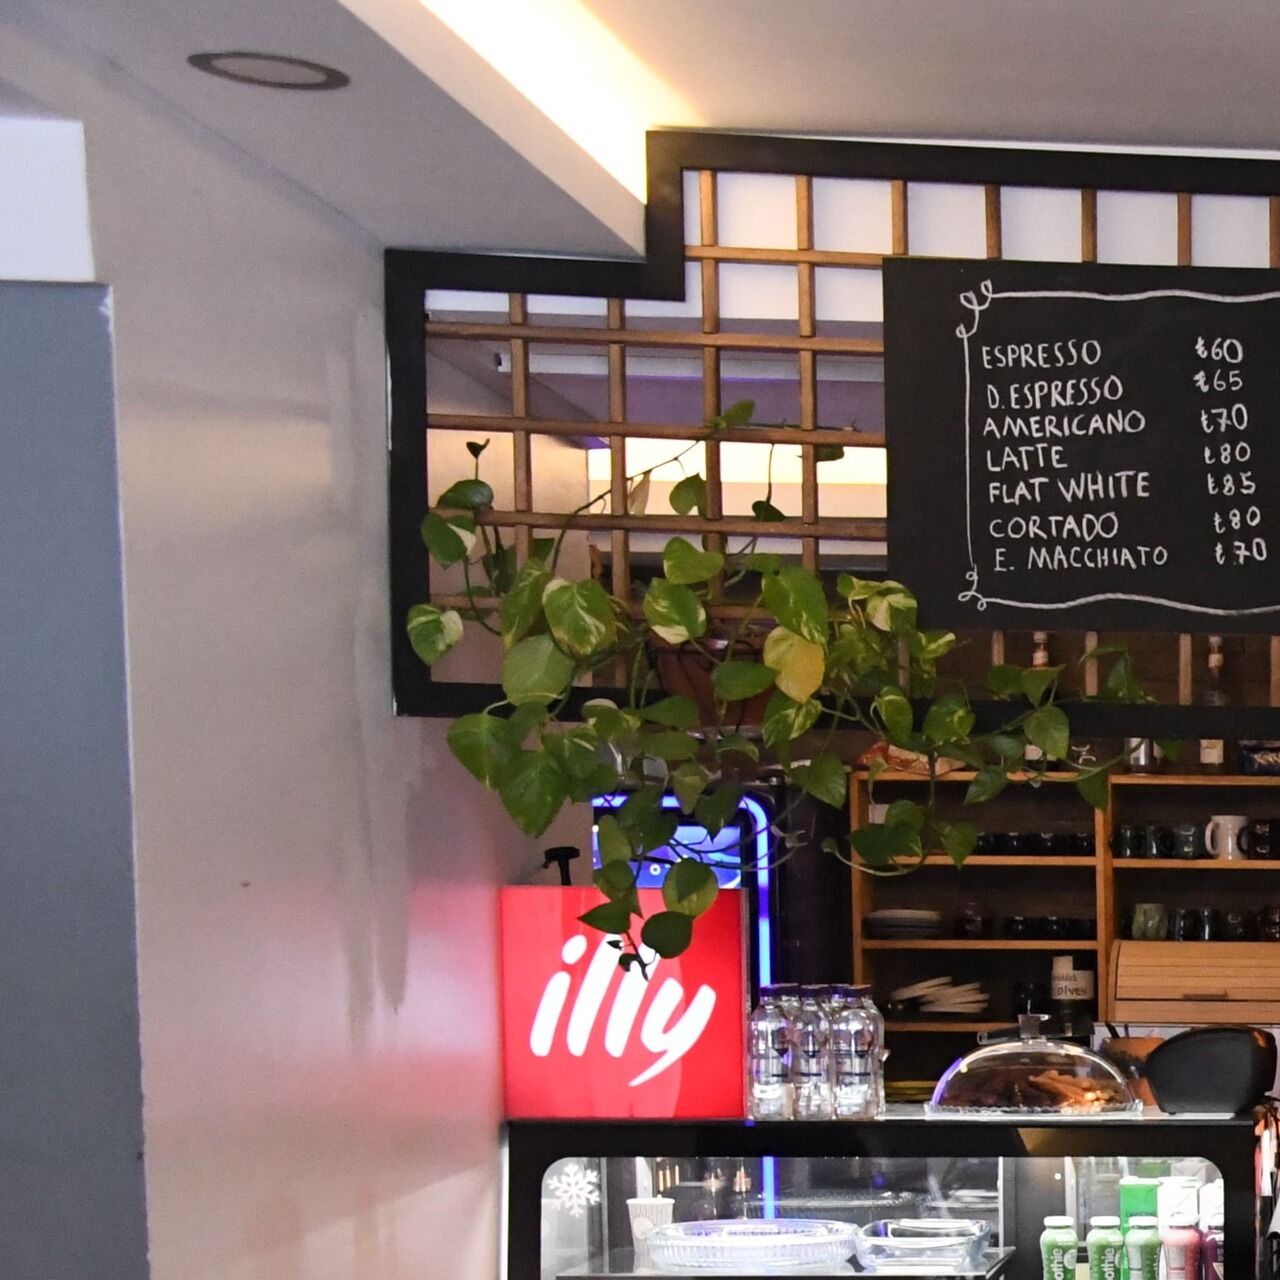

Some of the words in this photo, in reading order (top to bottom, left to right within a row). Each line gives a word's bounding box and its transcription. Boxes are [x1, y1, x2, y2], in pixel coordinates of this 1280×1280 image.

[982, 339, 1101, 369] ESPRESSO
[983, 409, 1145, 439] AMERICANO
[987, 443, 1068, 472] LATTE
[989, 477, 1049, 505] FLAT
[1058, 471, 1149, 502] WHITE
[989, 512, 1118, 542] CORTADO
[1028, 545, 1168, 570] MACCHIATO
[530, 933, 717, 1087] illy
